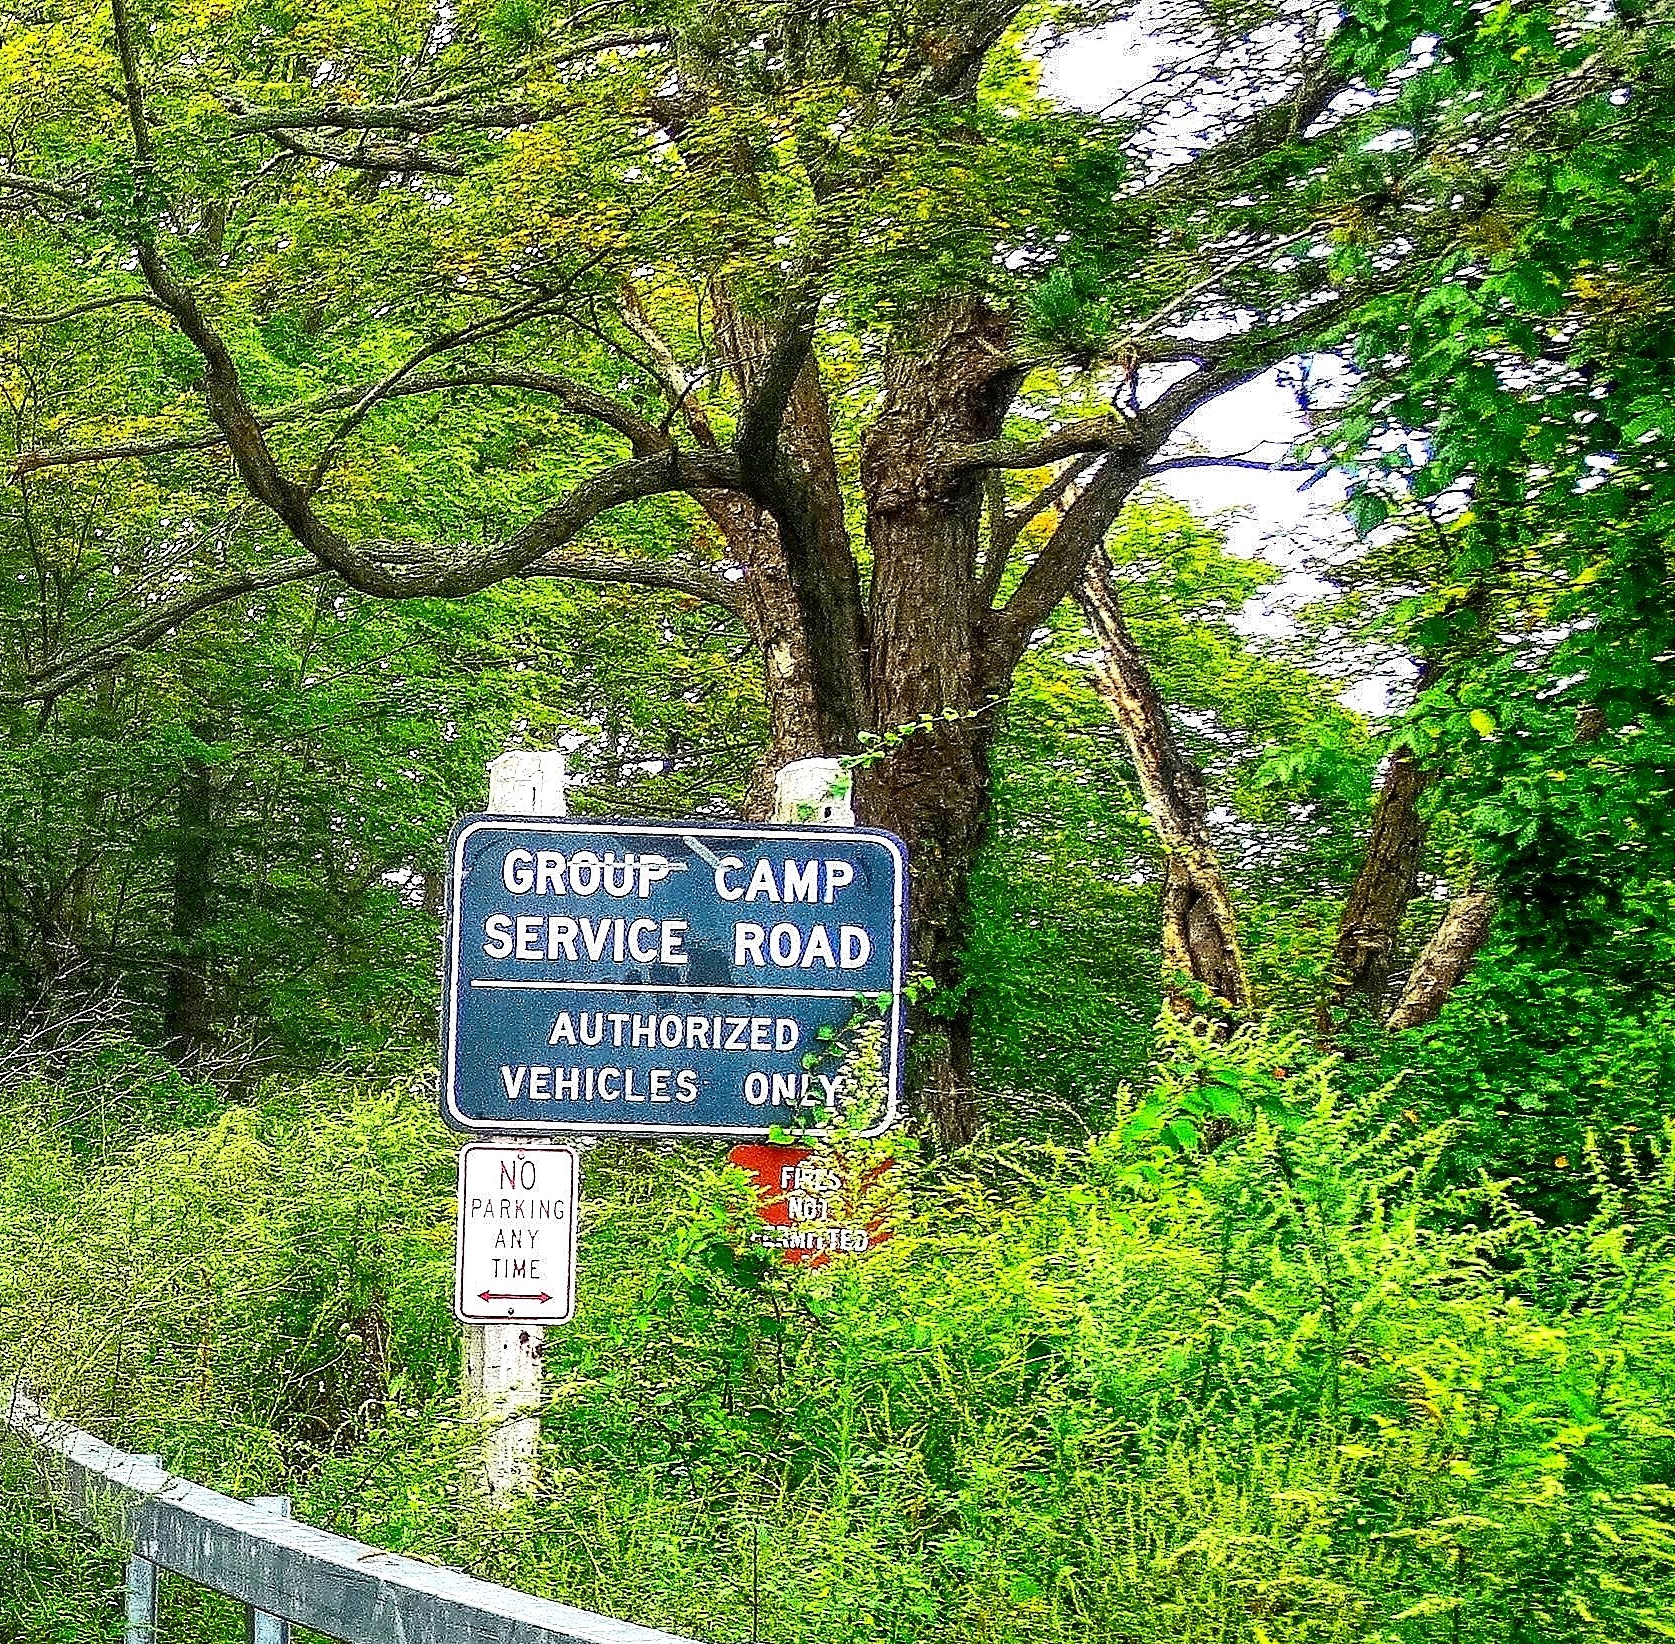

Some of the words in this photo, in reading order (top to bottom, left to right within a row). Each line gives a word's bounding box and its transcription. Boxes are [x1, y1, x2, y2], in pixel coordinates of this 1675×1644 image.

[503, 848, 669, 899] GROUP
[714, 856, 854, 904] CAMP
[483, 914, 688, 965] SERVICE
[734, 922, 871, 970] ROAD
[548, 1011, 800, 1052] AUTHORIZED
[501, 1066, 699, 1104] VEHICLES
[745, 1071, 845, 1107] ONLY
[501, 1161, 536, 1190] NO
[471, 1198, 564, 1220] PARKING
[495, 1229, 539, 1249] ANY
[492, 1258, 540, 1279] TIME
